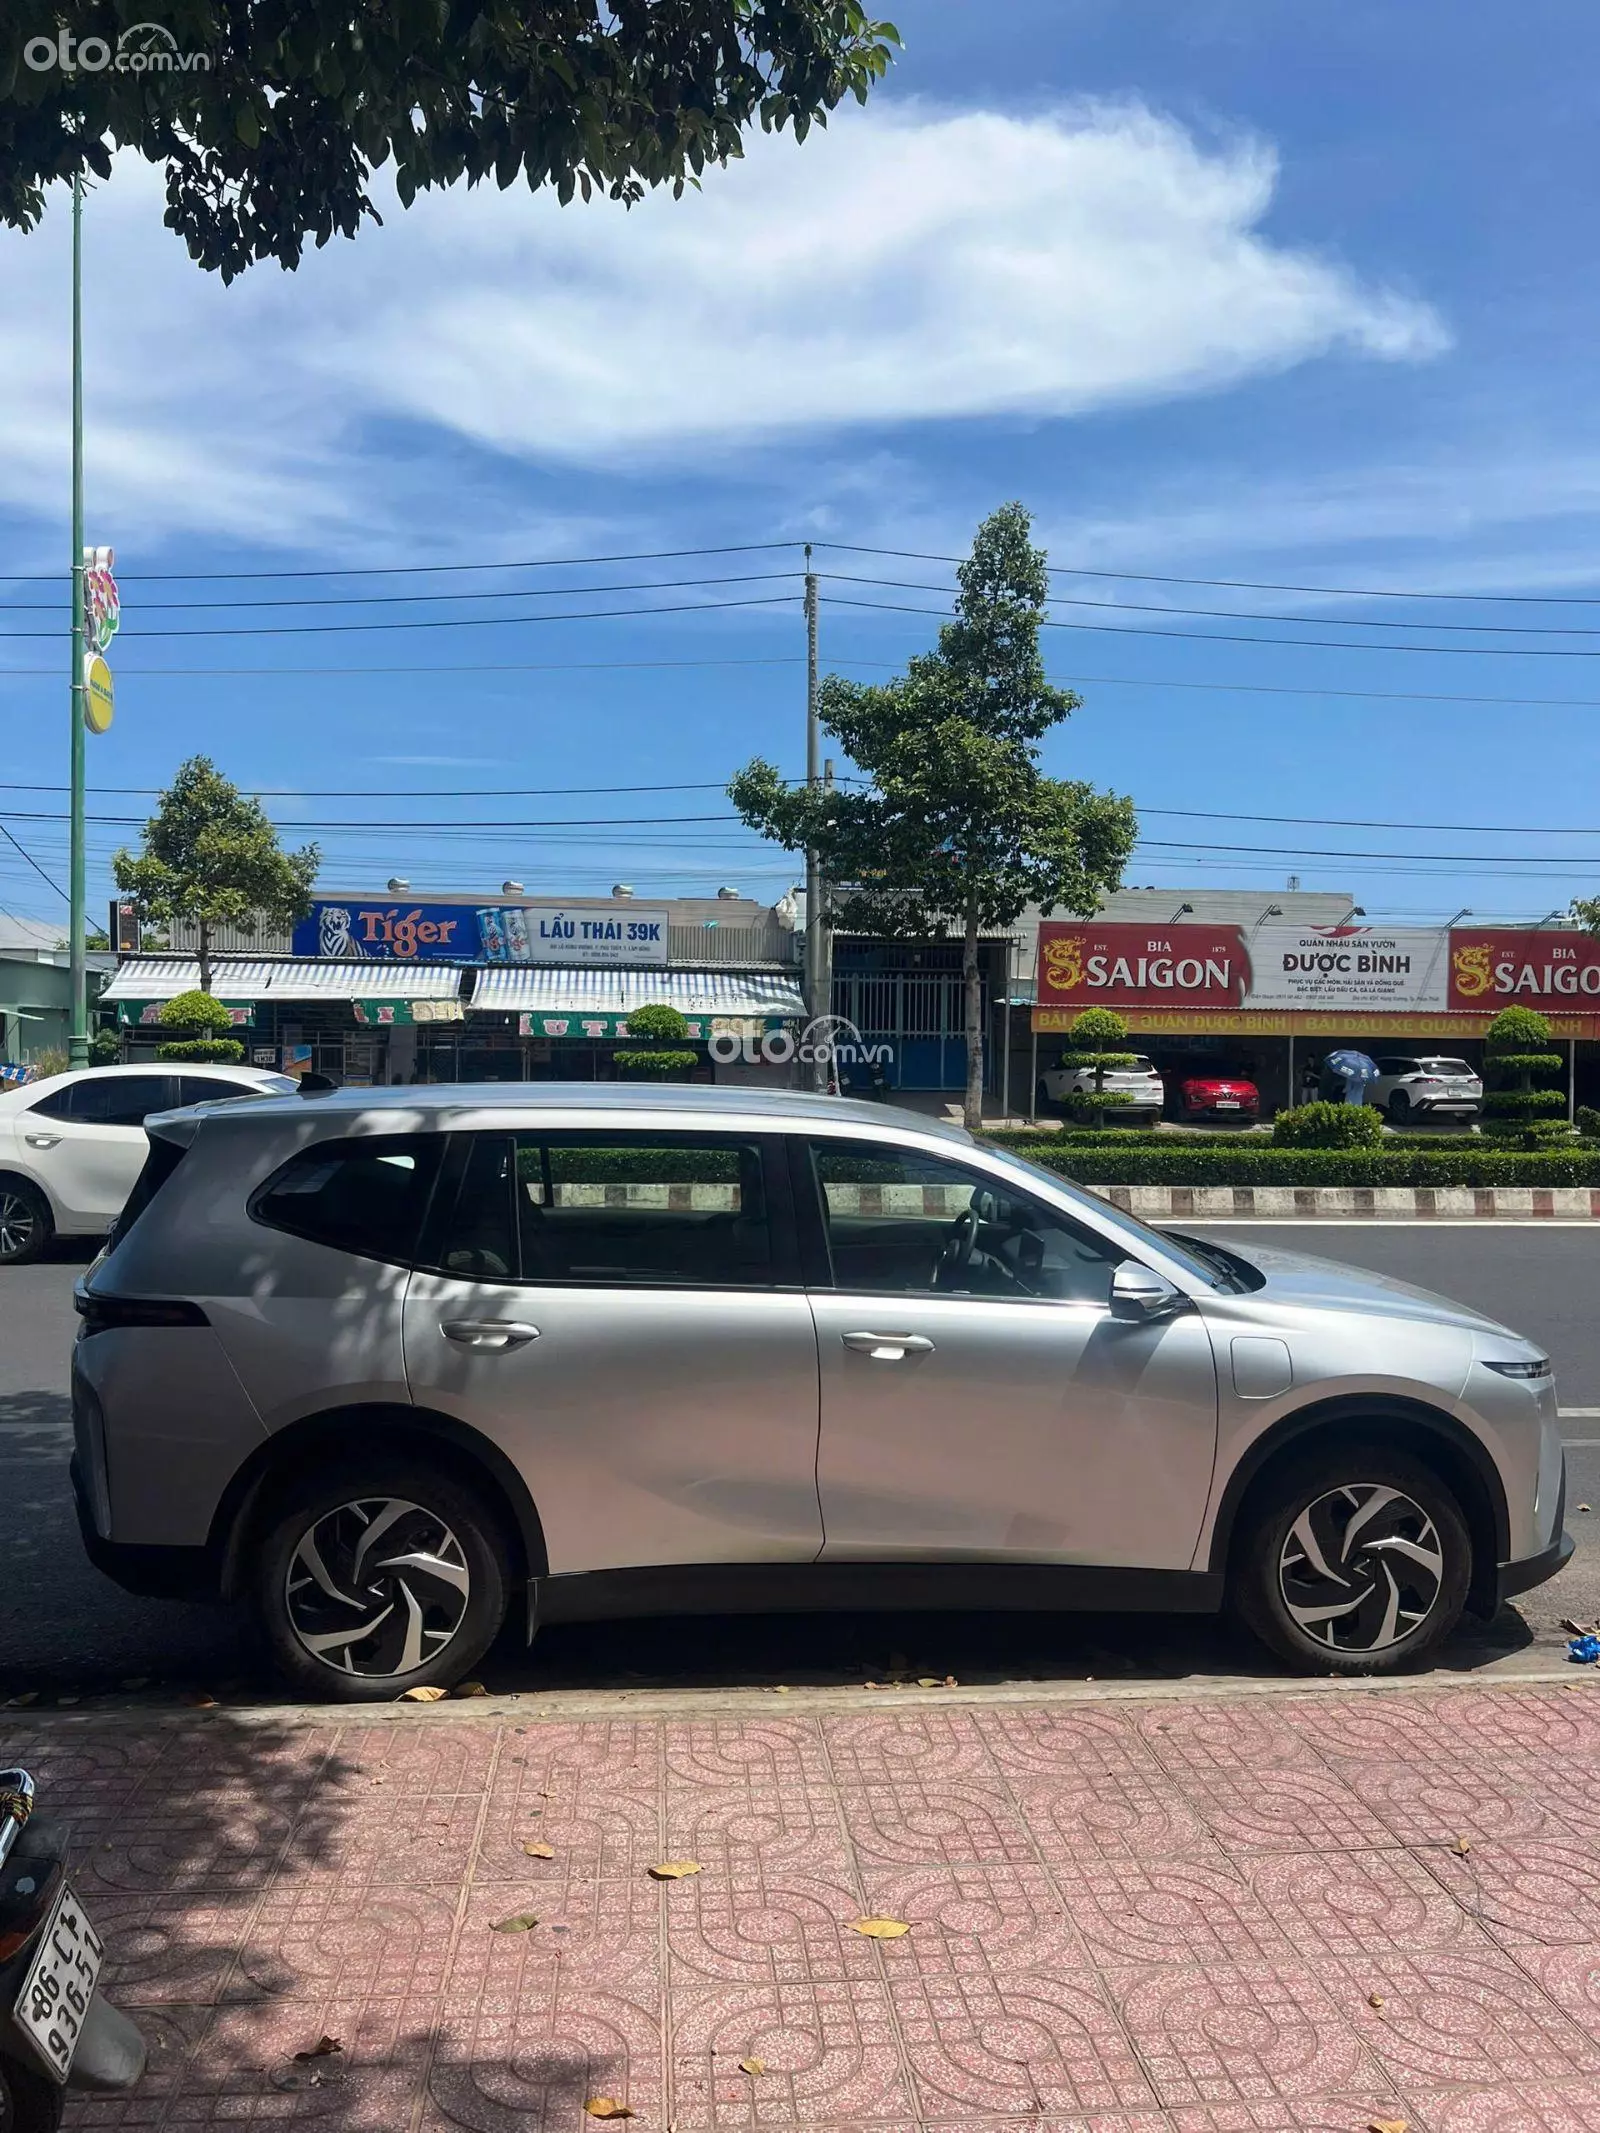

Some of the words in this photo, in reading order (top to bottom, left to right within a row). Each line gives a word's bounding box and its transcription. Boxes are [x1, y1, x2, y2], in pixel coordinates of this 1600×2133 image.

[358, 909, 457, 957] Tiger
[540, 913, 575, 939] LẨU
[581, 918, 622, 941] THÁI
[626, 922, 661, 941] 39K
[1147, 941, 1172, 952] BIA
[1552, 948, 1577, 959] BIA
[1086, 956, 1231, 989] SAIGON
[1282, 952, 1351, 978] ĐƯỢC
[1357, 950, 1410, 973] BÌNH
[1389, 1018, 1414, 1032] XE
[31, 1912, 80, 2022] 86-C1
[48, 1930, 101, 2068] 936.51
